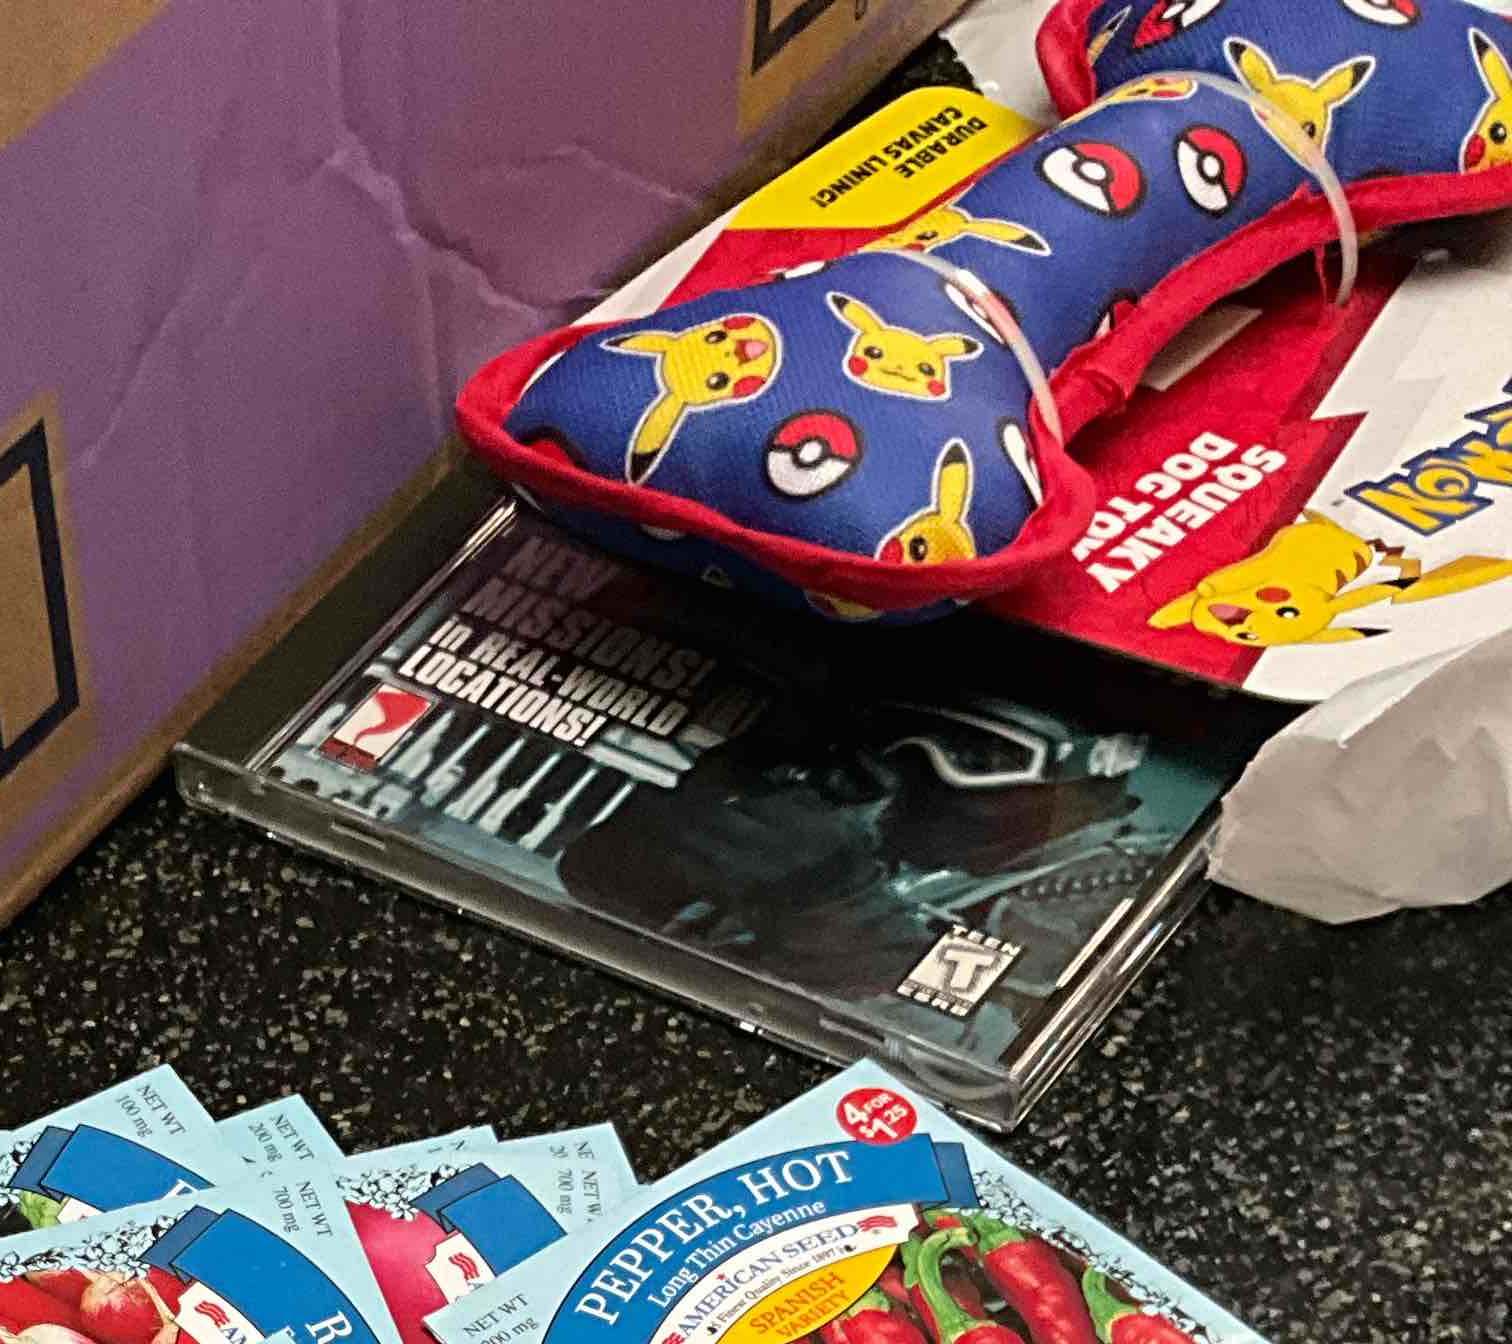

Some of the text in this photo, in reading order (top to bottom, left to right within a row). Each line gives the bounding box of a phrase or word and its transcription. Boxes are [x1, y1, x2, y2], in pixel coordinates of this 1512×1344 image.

[811, 107, 963, 208] CANVAS LINING!
[893, 117, 987, 178] DURABLE
[1135, 431, 1239, 500] DOG
[1086, 444, 1286, 592] SQUEAKY
[398, 643, 607, 747] LOCATIONS!
[469, 631, 687, 736] REAL-WORLD
[952, 924, 1022, 955] TEEN
[574, 1150, 853, 1325] PEPPER, HOT
[648, 1200, 827, 1308] Long Thin Cayenne
[681, 1223, 858, 1336] AMERICAN SEED
[463, 1293, 529, 1338] NET WT
[511, 1317, 539, 1336] mg
[750, 1271, 846, 1334] SPANISH
[776, 1289, 850, 1338] VARIETY
